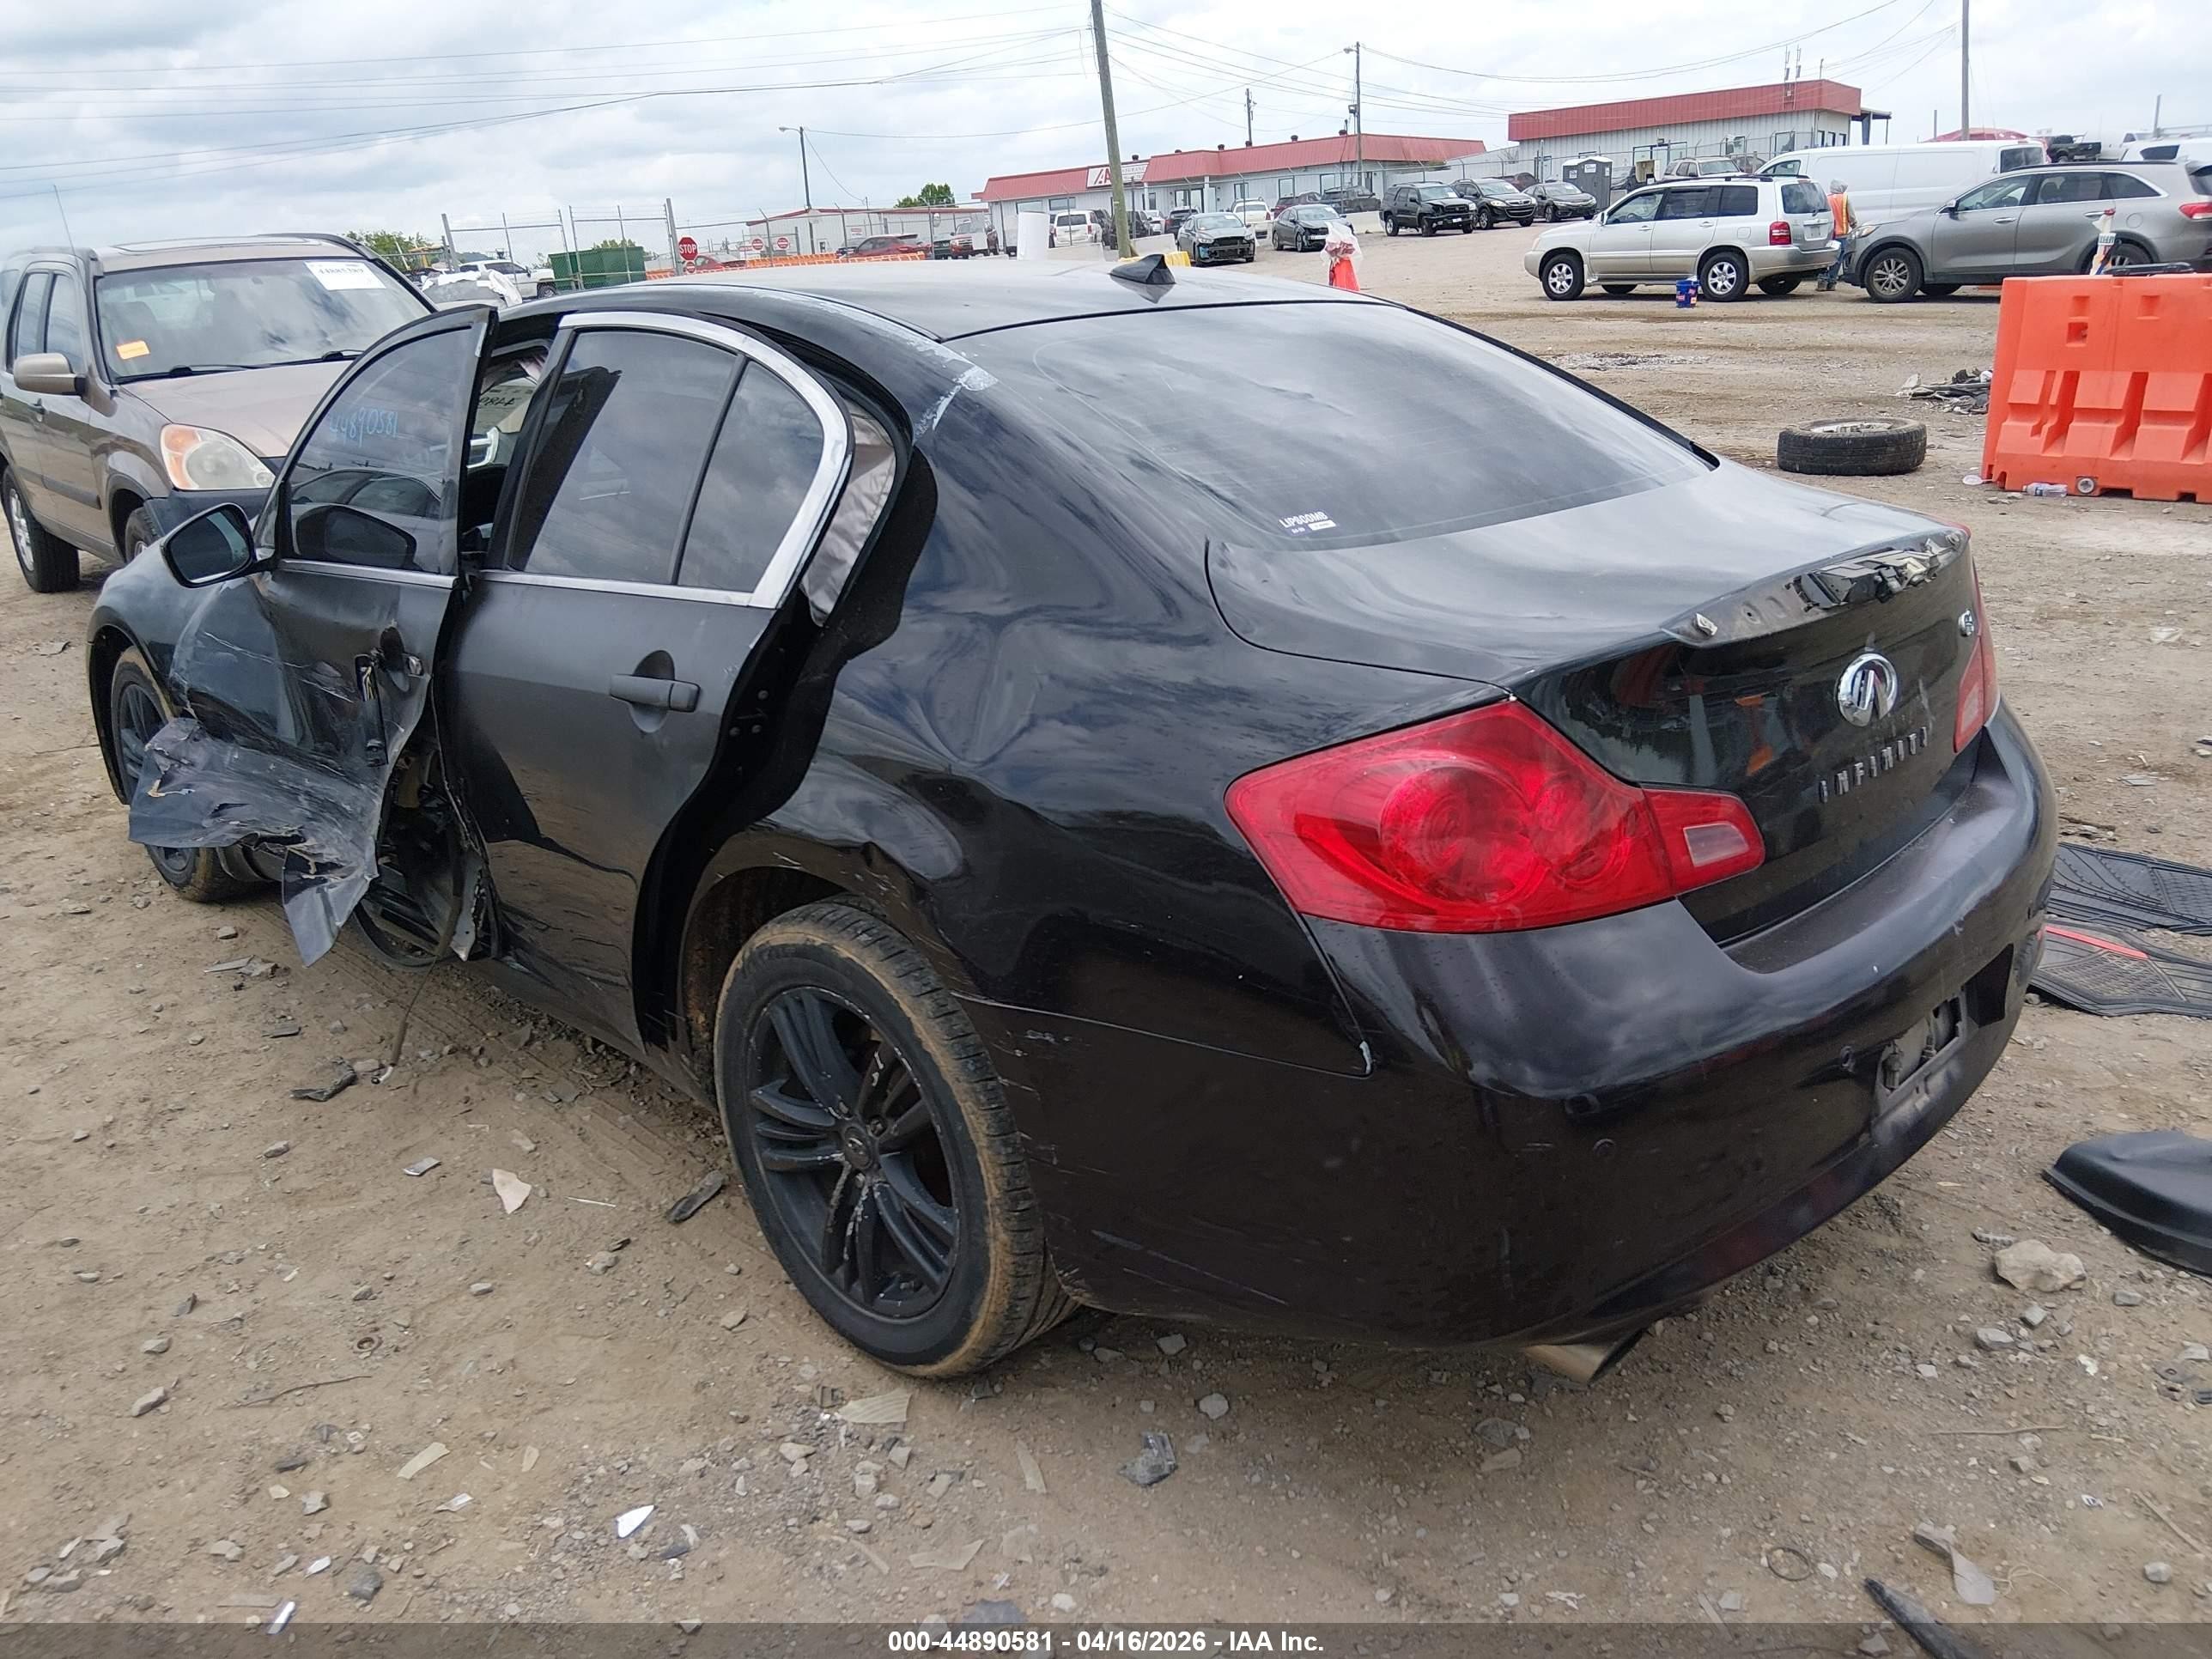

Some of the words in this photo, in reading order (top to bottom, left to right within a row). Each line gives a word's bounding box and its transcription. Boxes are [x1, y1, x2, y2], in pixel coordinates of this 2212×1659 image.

[679, 244, 696, 253] STOP
[1279, 511, 1328, 528] LIPSCOMB
[1819, 726, 1929, 804] INFINITI
